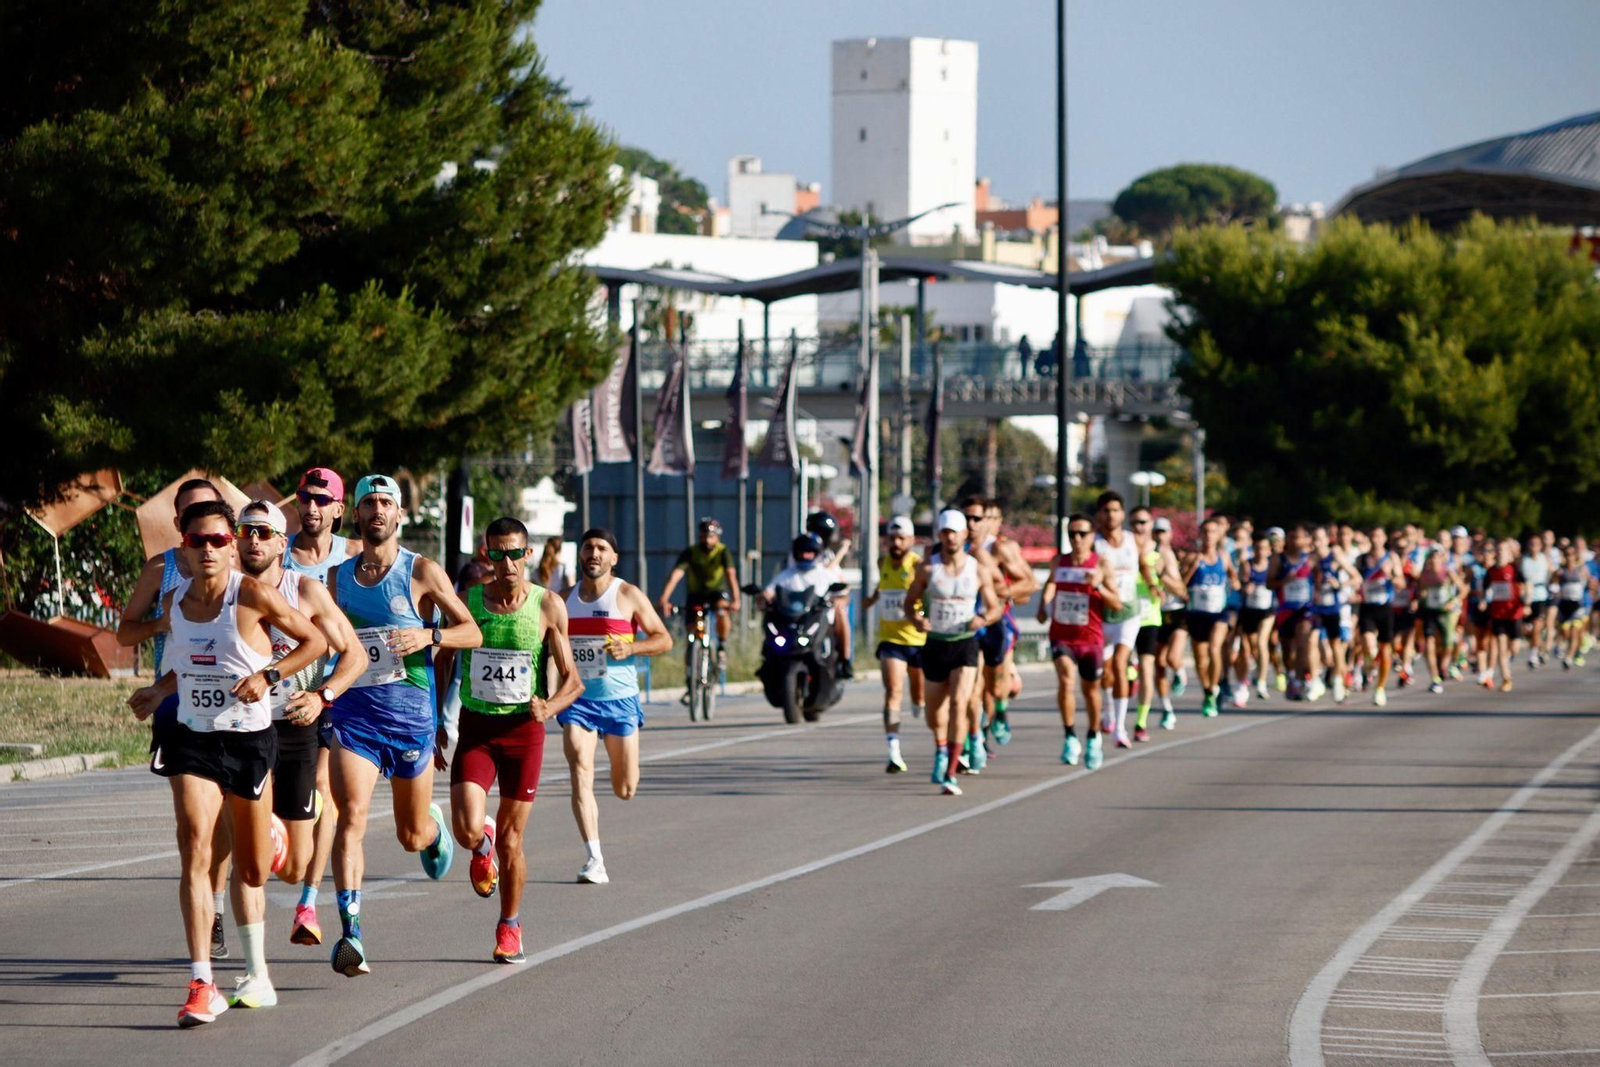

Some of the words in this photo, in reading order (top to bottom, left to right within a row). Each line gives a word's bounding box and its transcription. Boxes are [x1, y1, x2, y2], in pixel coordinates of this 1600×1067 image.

[365, 646, 380, 663] 9
[572, 648, 595, 662] 589
[482, 664, 517, 682] 244
[191, 688, 226, 708] 559
